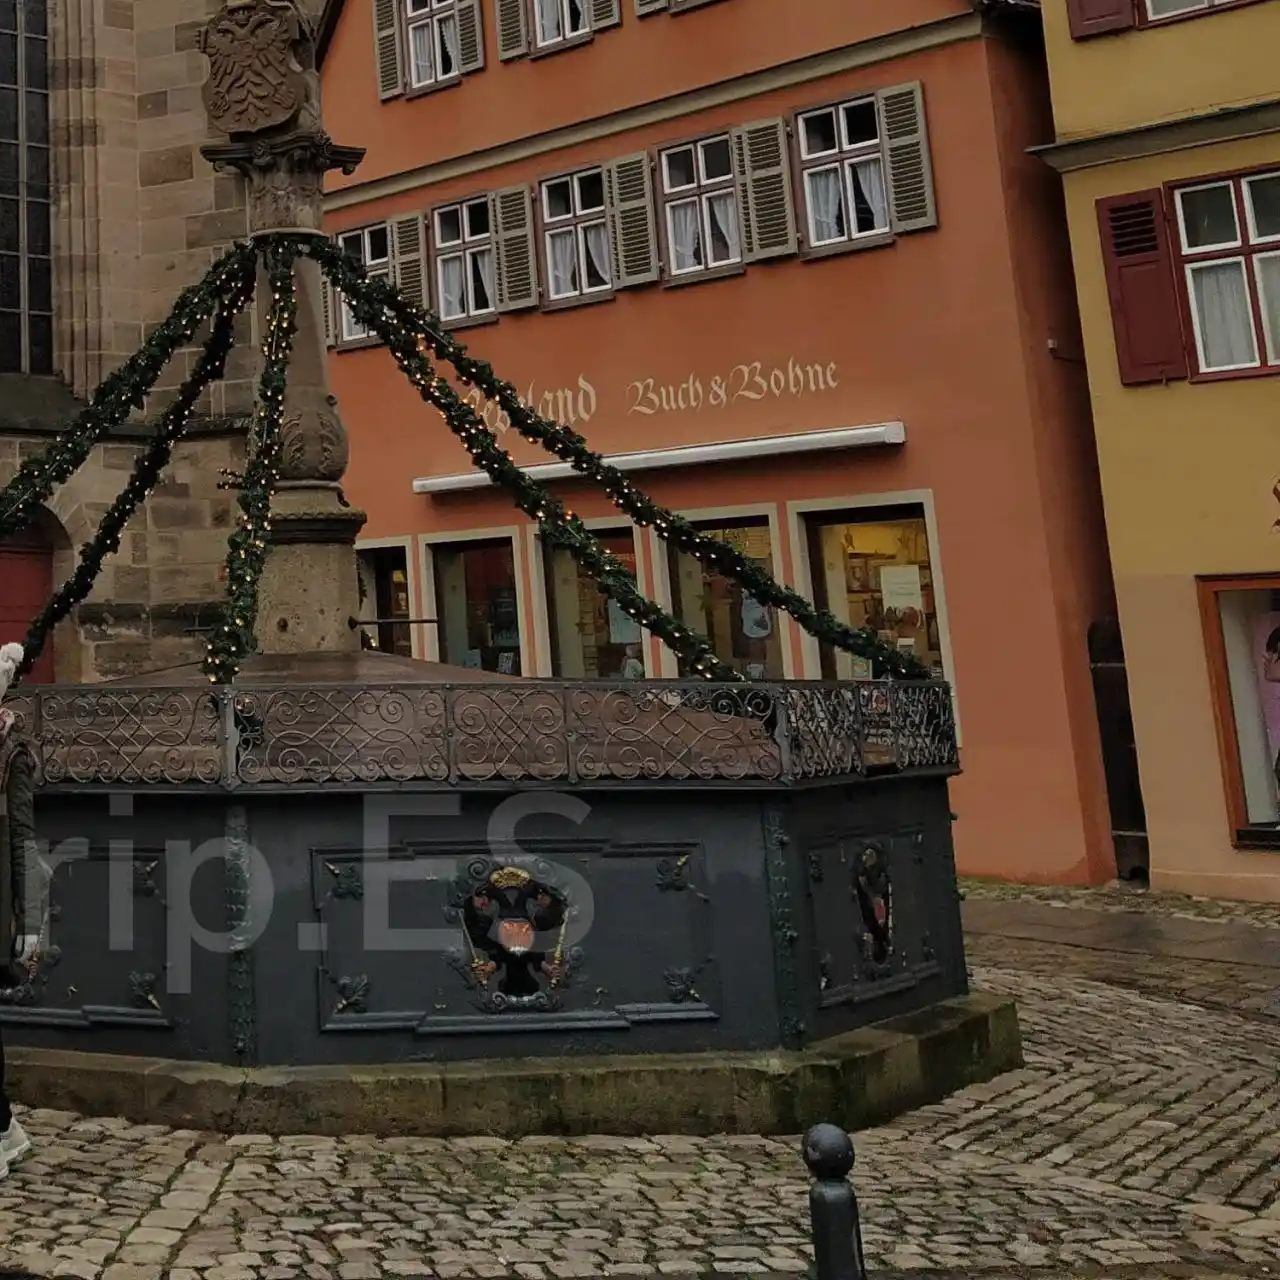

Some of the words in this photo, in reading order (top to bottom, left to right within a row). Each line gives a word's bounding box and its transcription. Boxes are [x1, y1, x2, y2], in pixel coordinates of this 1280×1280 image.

[625, 372, 703, 417] Buch
[708, 375, 728, 409] &
[729, 356, 840, 404] Bohne
